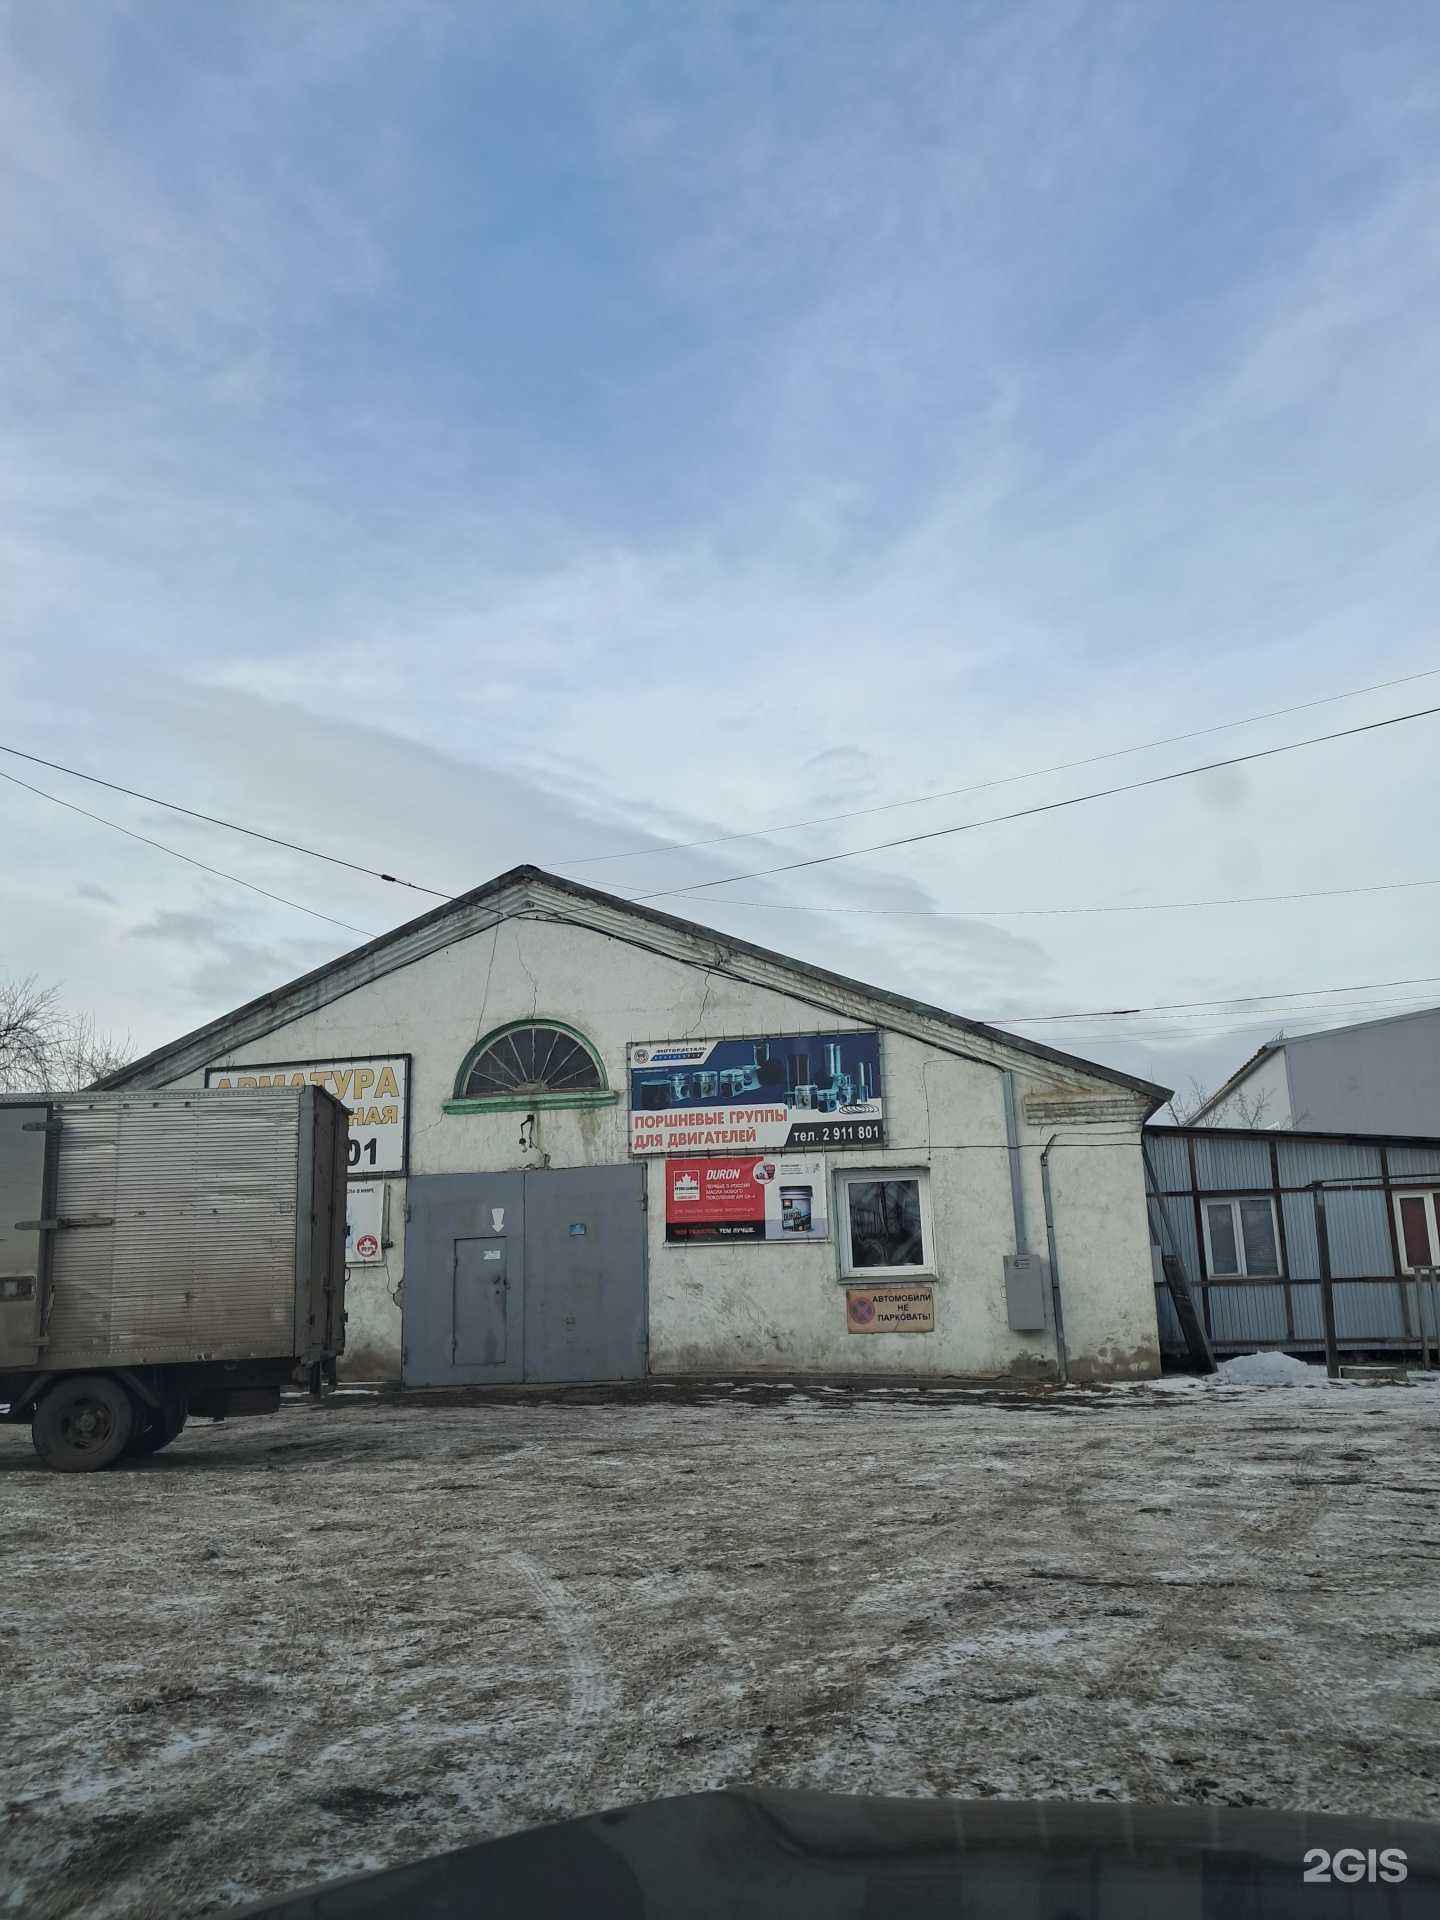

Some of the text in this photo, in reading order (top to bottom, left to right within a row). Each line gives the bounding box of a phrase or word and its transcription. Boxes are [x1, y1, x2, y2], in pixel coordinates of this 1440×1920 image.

[350, 1105, 399, 1126] НАЯ
[634, 1108, 788, 1129] ПОРШНЕВЫЕ ГРУППЫ
[634, 1127, 757, 1149] ДЛЯ ДВИГАТЕЛЕЙ
[793, 1125, 879, 1142] тел. 2 911 801
[348, 1138, 377, 1166] 01
[706, 1168, 741, 1181] DURON
[872, 1294, 931, 1302] АВТОМОБИЛИ
[897, 1304, 910, 1312] НЕ
